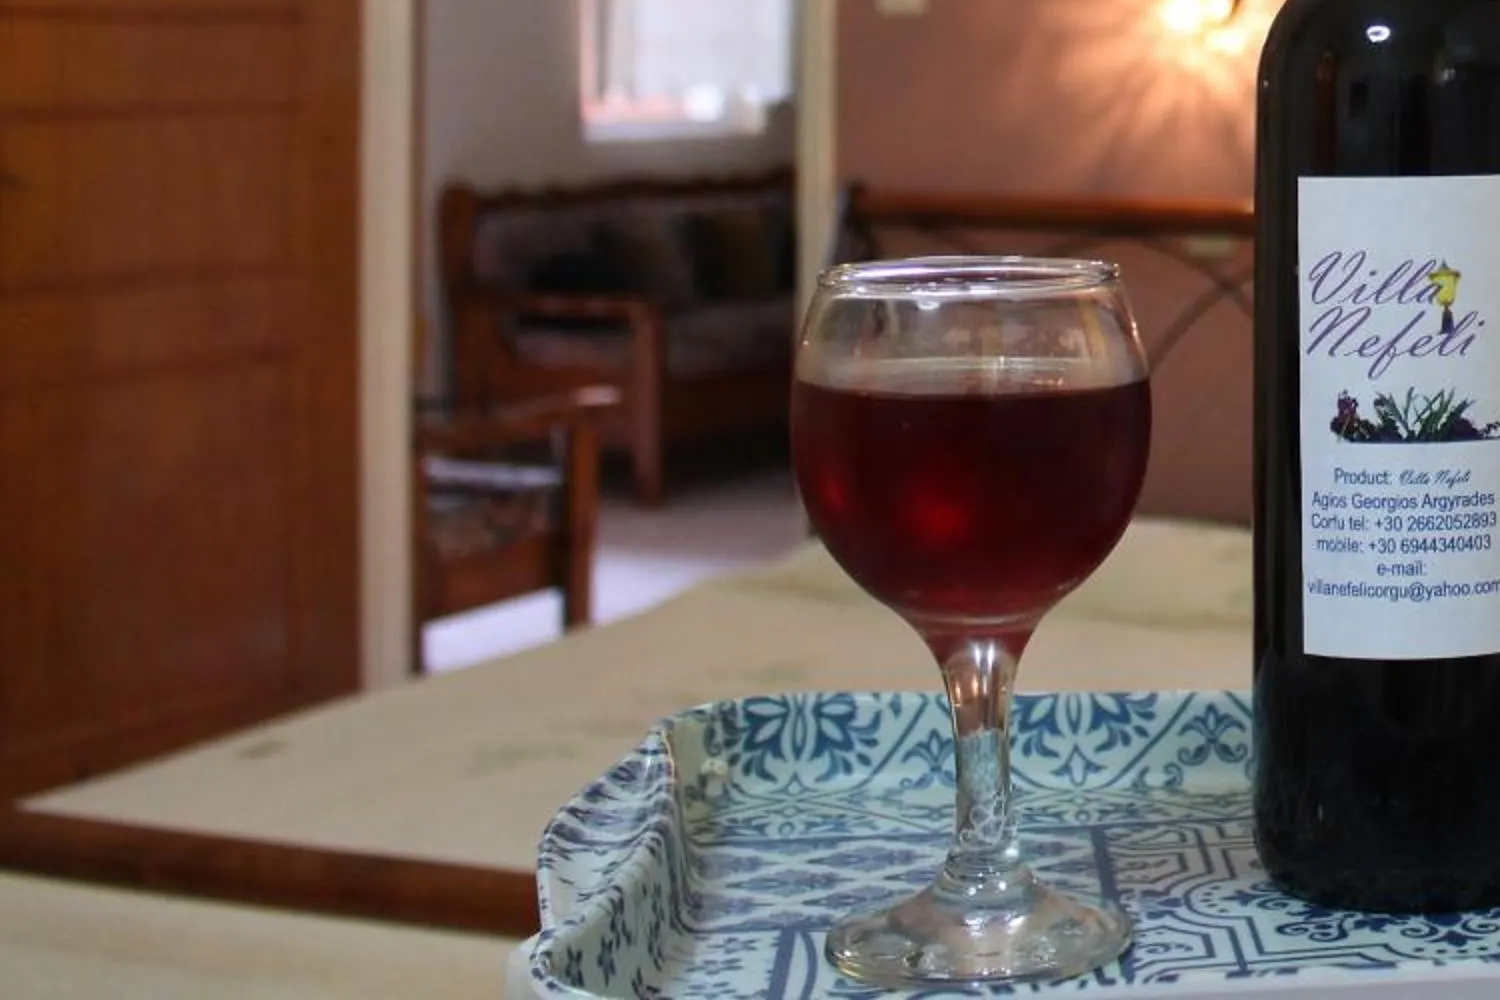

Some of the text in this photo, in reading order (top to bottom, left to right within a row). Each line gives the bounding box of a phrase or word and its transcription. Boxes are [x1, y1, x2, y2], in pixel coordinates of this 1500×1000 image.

[1308, 251, 1444, 305] Villa
[1306, 306, 1485, 380] Nefeli
[1334, 467, 1392, 485] Product:
[1311, 491, 1495, 512] Agios Georgios Argyrades
[1311, 512, 1497, 532] Corfu tel: +30 2662052893
[1316, 533, 1492, 554] mobile: +30 6944340403
[1377, 560, 1427, 576] e-mail:
